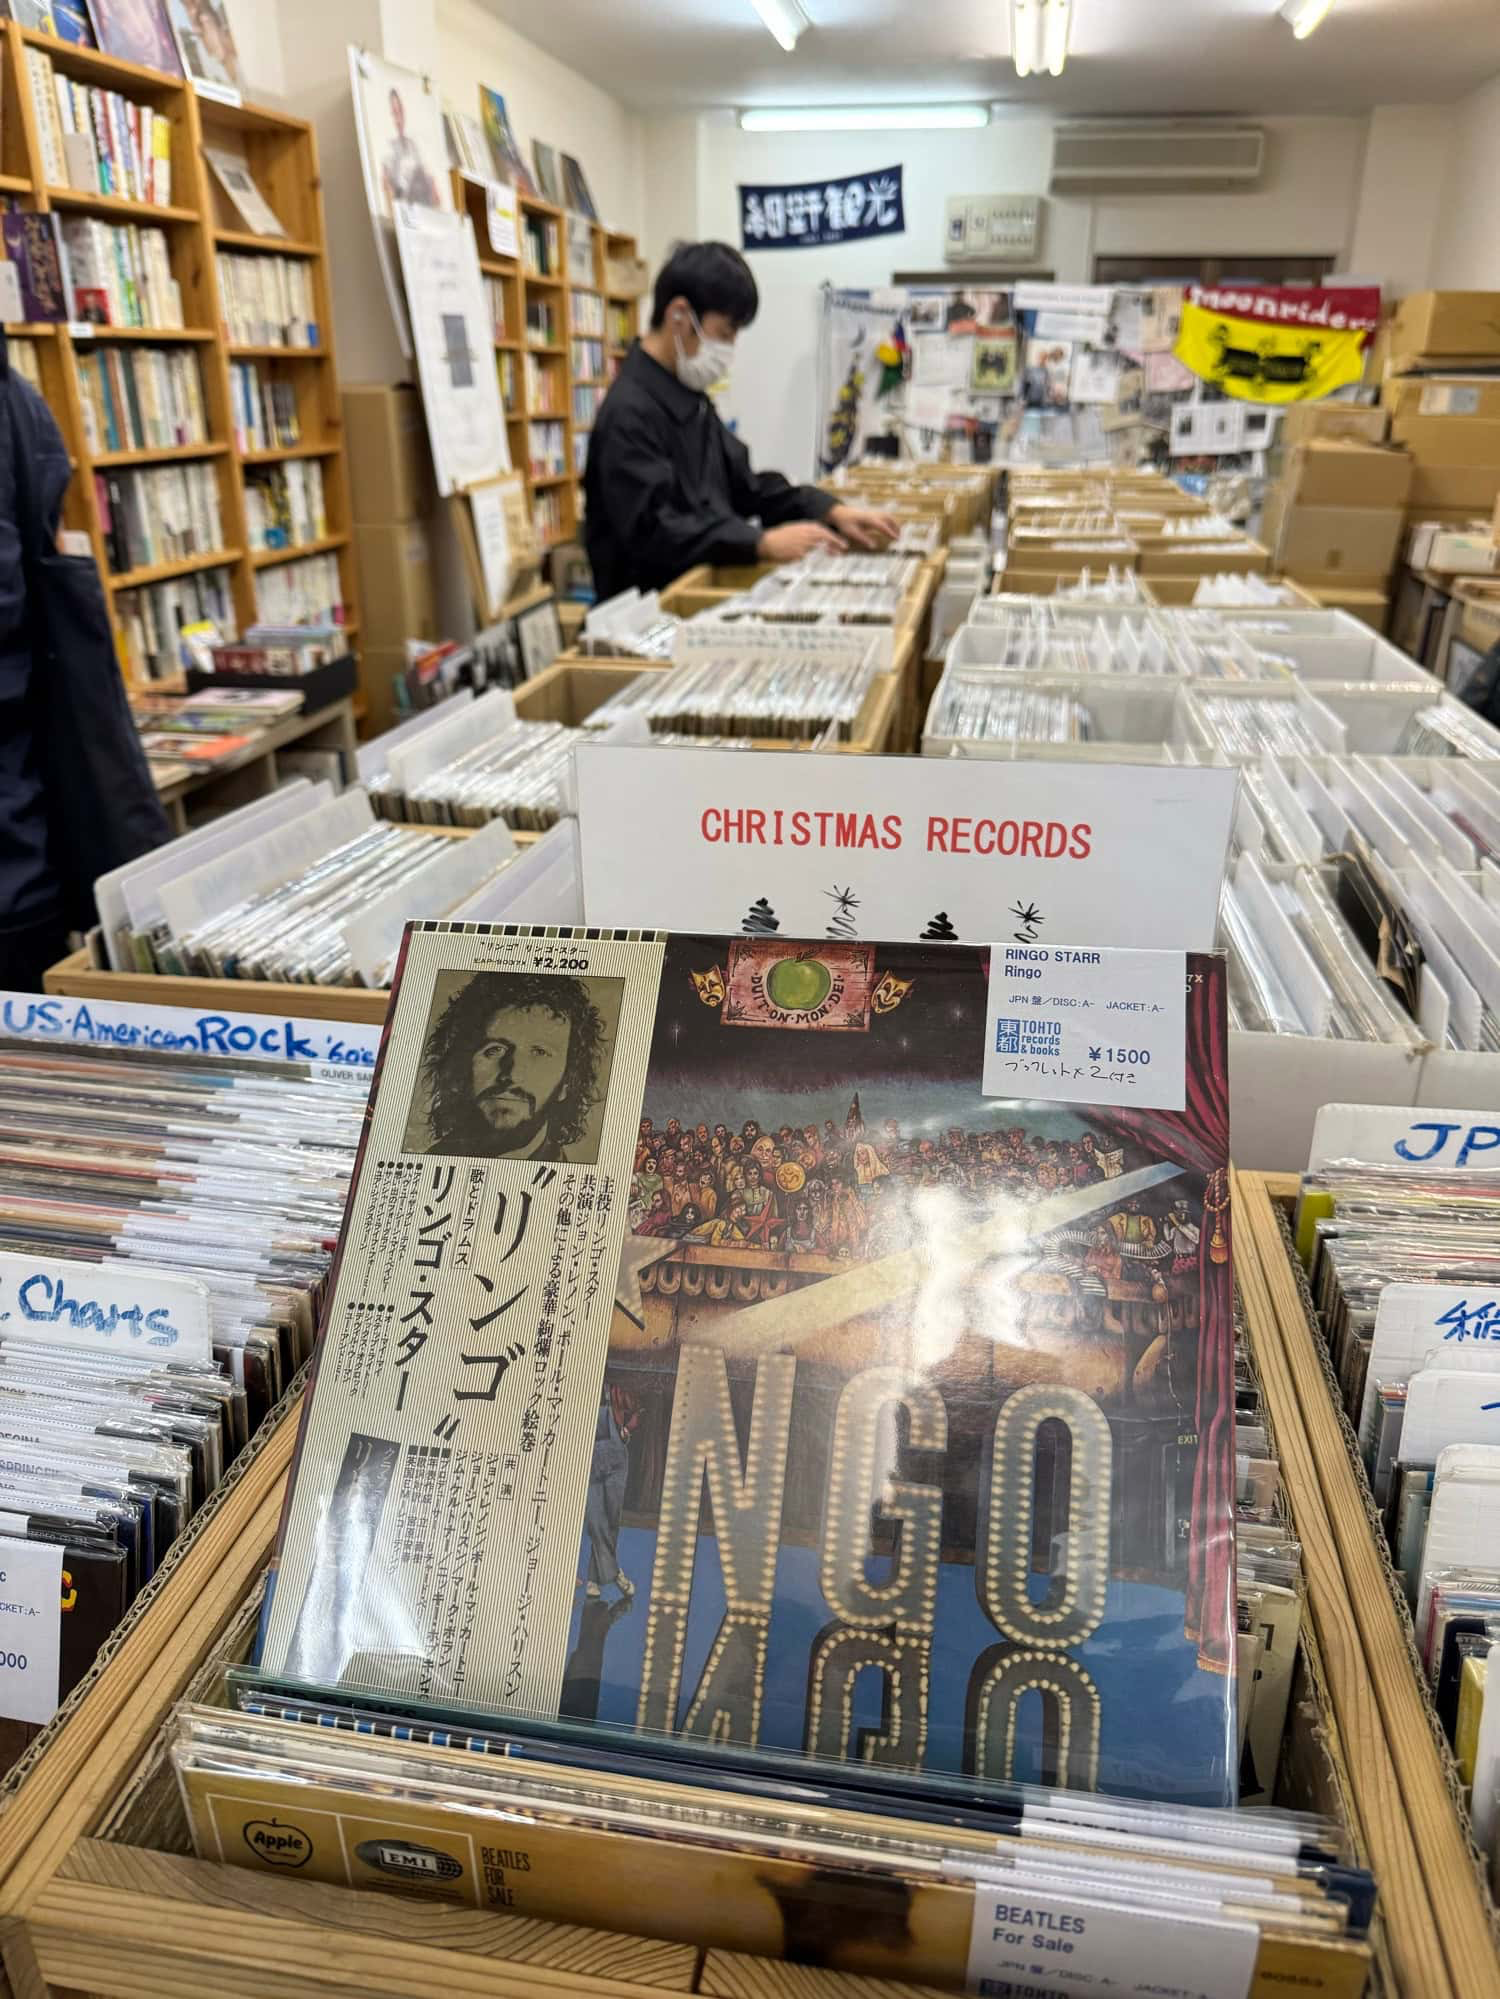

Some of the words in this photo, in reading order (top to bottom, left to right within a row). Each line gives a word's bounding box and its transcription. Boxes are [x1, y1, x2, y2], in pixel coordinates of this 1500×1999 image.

[701, 808, 903, 850] CHRISTMAS
[926, 815, 1092, 859] RECORDS
[533, 957, 588, 971] ¥2,200
[1005, 949, 1049, 961] RINGO
[1055, 952, 1100, 964] STARR
[1004, 965, 1042, 979] Ringo
[1008, 994, 1029, 1005] JPN
[997, 1019, 1020, 1053] 東都
[1022, 1020, 1061, 1035] TOHTO
[1021, 1035, 1060, 1046] records
[1029, 1046, 1060, 1056] books
[1088, 1047, 1151, 1065] ¥1500
[454, 1168, 484, 1267] 歌とドラムス
[395, 1165, 457, 1411] リンゴ・スター
[19, 1274, 178, 1346] Charts
[1177, 1434, 1199, 1446] EXIT
[254, 1829, 303, 1851] Apple
[386, 1852, 429, 1869] EMI
[481, 1847, 531, 1872] BEATLES
[484, 1867, 504, 1887] FOR
[488, 1886, 514, 1906] SALE
[994, 1904, 1086, 1934] BEATLES
[992, 1927, 1025, 1946] For
[1031, 1934, 1074, 1954] Sale
